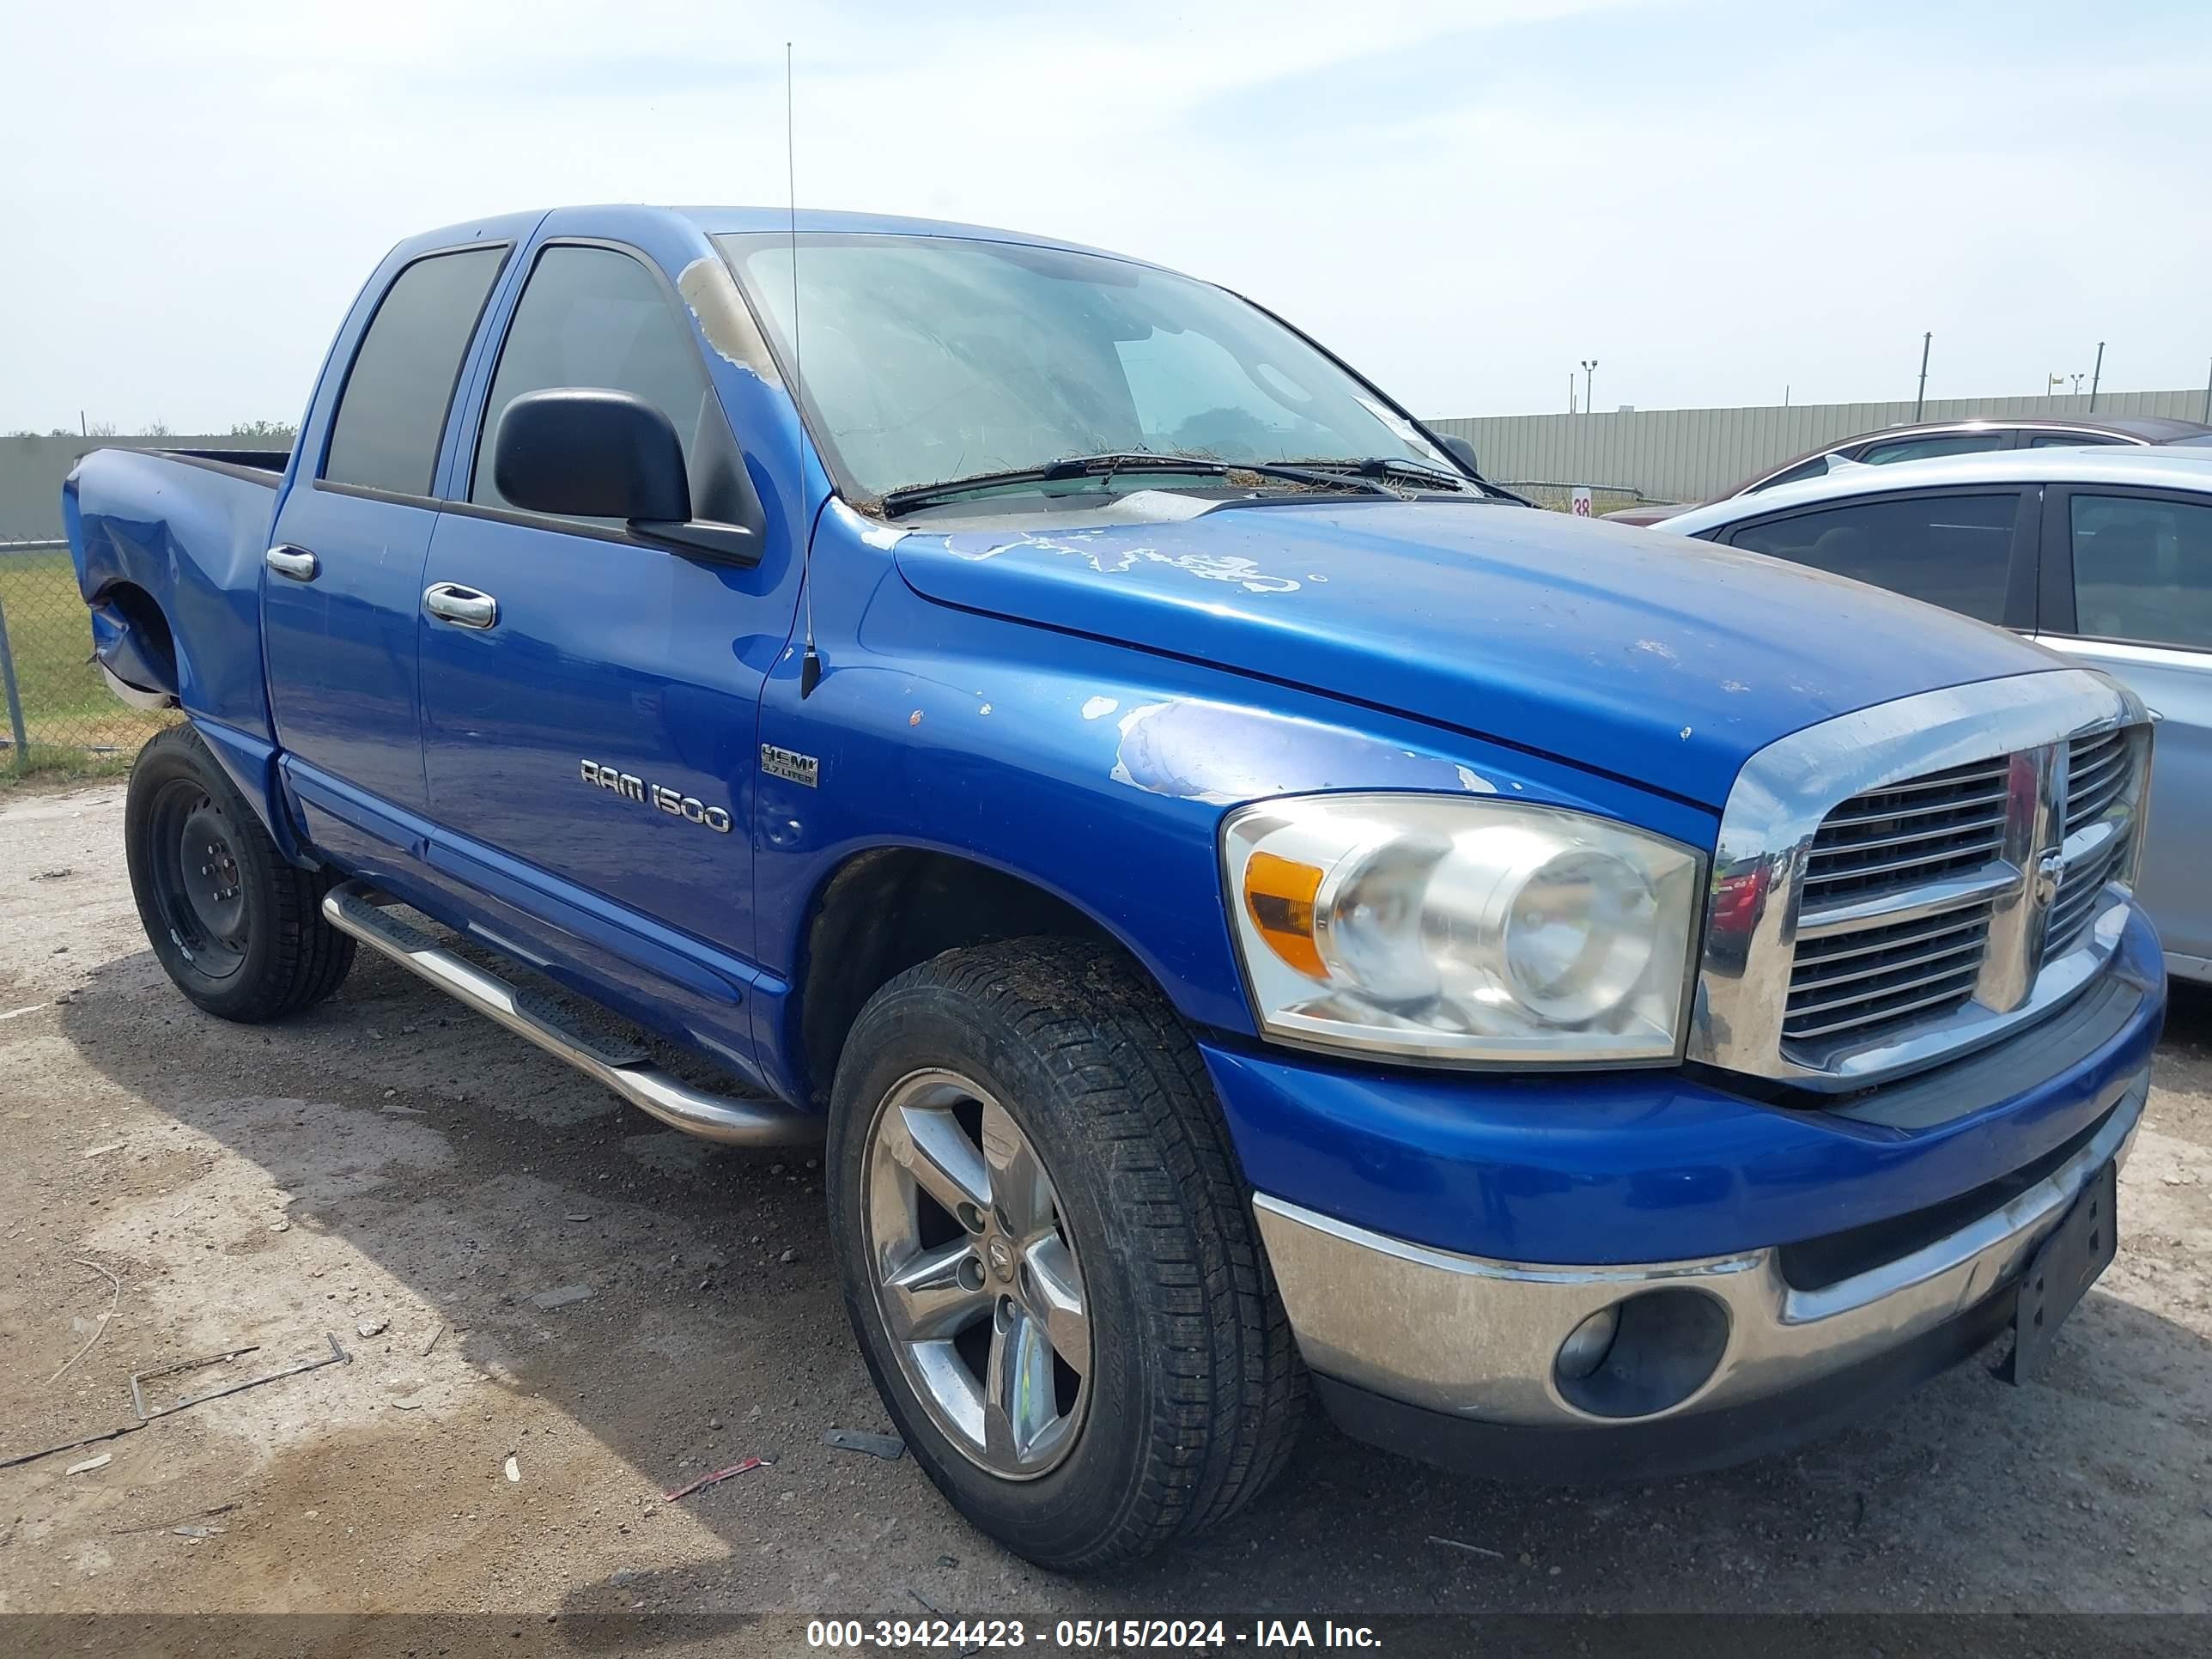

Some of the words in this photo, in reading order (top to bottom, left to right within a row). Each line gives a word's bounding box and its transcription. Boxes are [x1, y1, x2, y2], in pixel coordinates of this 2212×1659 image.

[763, 745, 817, 771] HEMI
[781, 768, 813, 783] LITER
[580, 758, 647, 802] RAM
[652, 783, 731, 833] 1500
